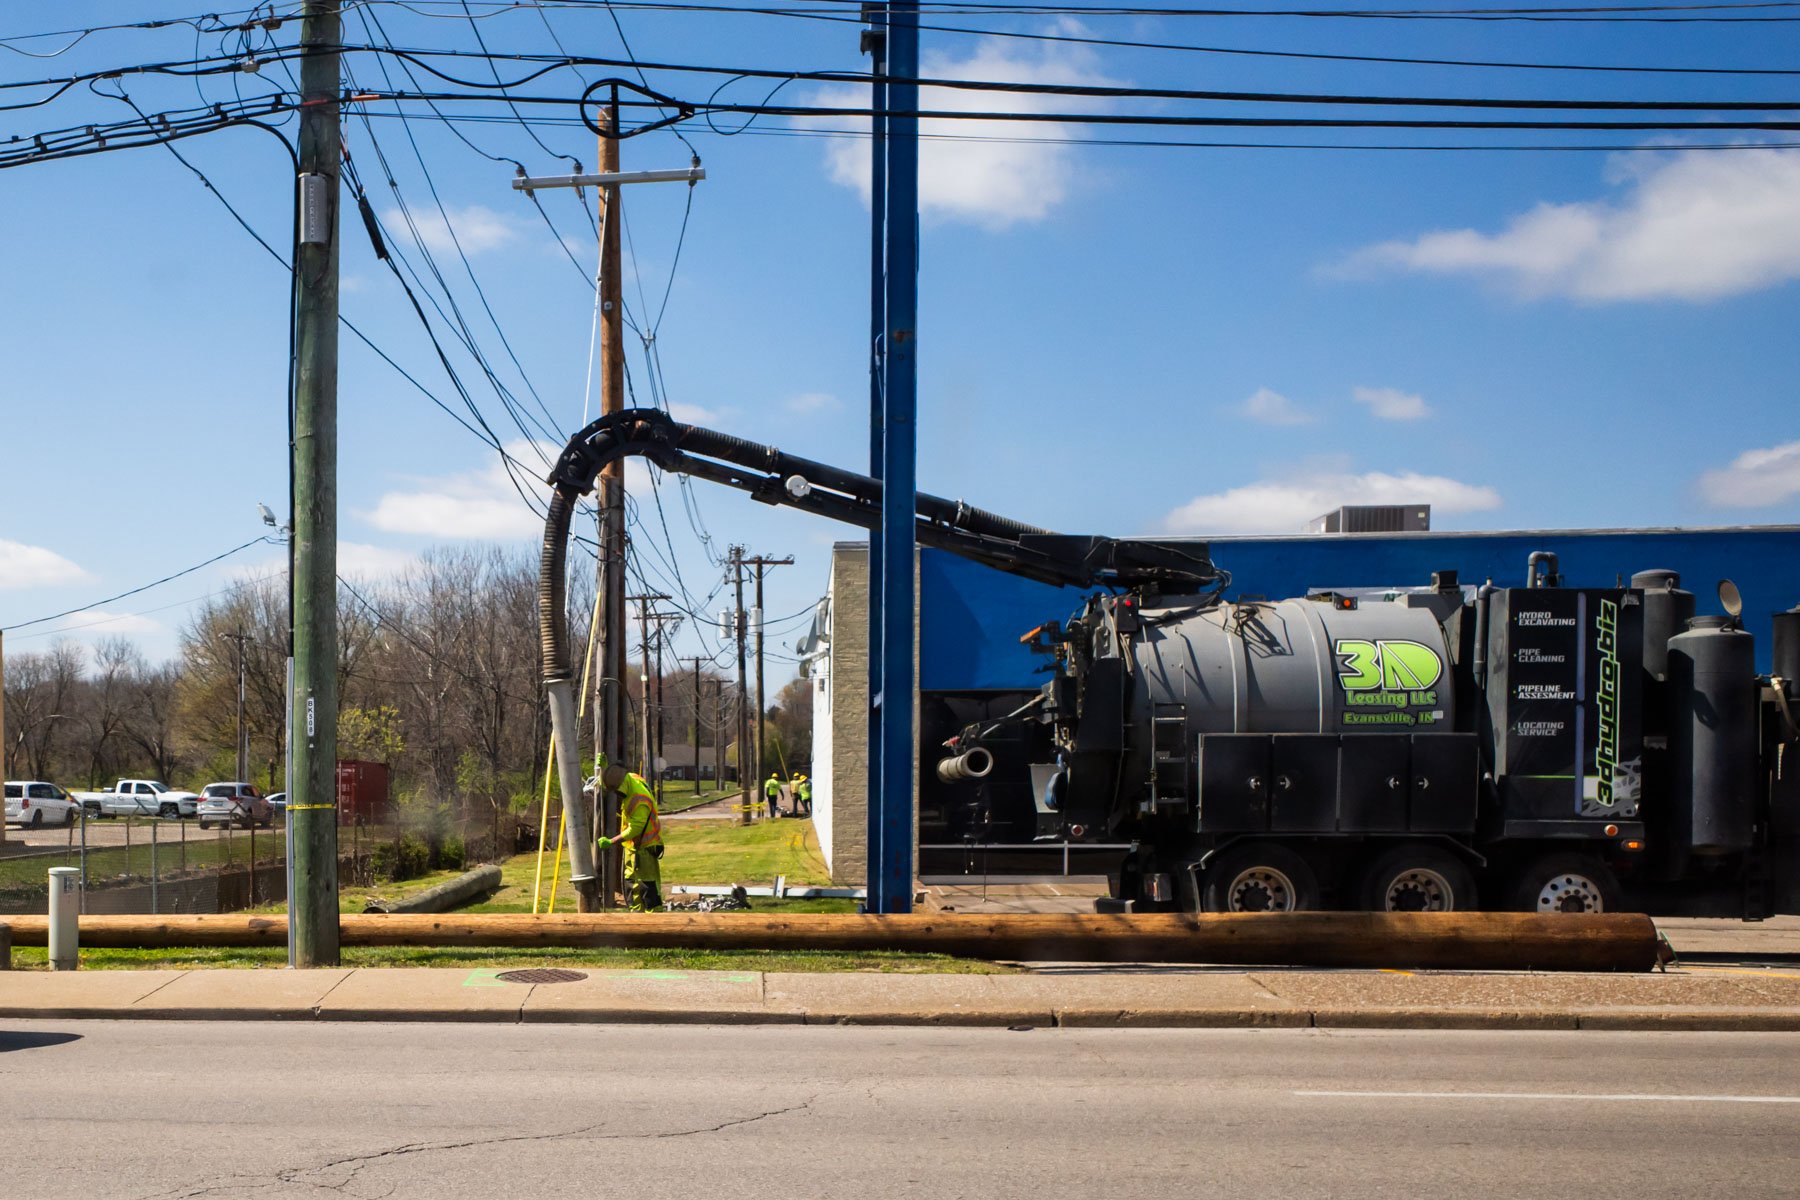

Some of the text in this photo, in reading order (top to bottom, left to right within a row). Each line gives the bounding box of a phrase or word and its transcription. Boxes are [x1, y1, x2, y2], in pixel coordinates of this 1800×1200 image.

[1518, 618, 1576, 626] EXCAVATING
[1519, 648, 1541, 656] PIPE
[1518, 655, 1565, 663] CLEANING
[1335, 639, 1443, 691] 3D
[1346, 690, 1437, 709] Leasing LLC
[1518, 691, 1576, 700] ASSESMENT
[1596, 598, 1620, 808] 3dhydro.biz
[1343, 711, 1434, 727] Evansville, IN
[1517, 721, 1565, 729] LOCATING
[1517, 728, 1557, 737] SERVICE
